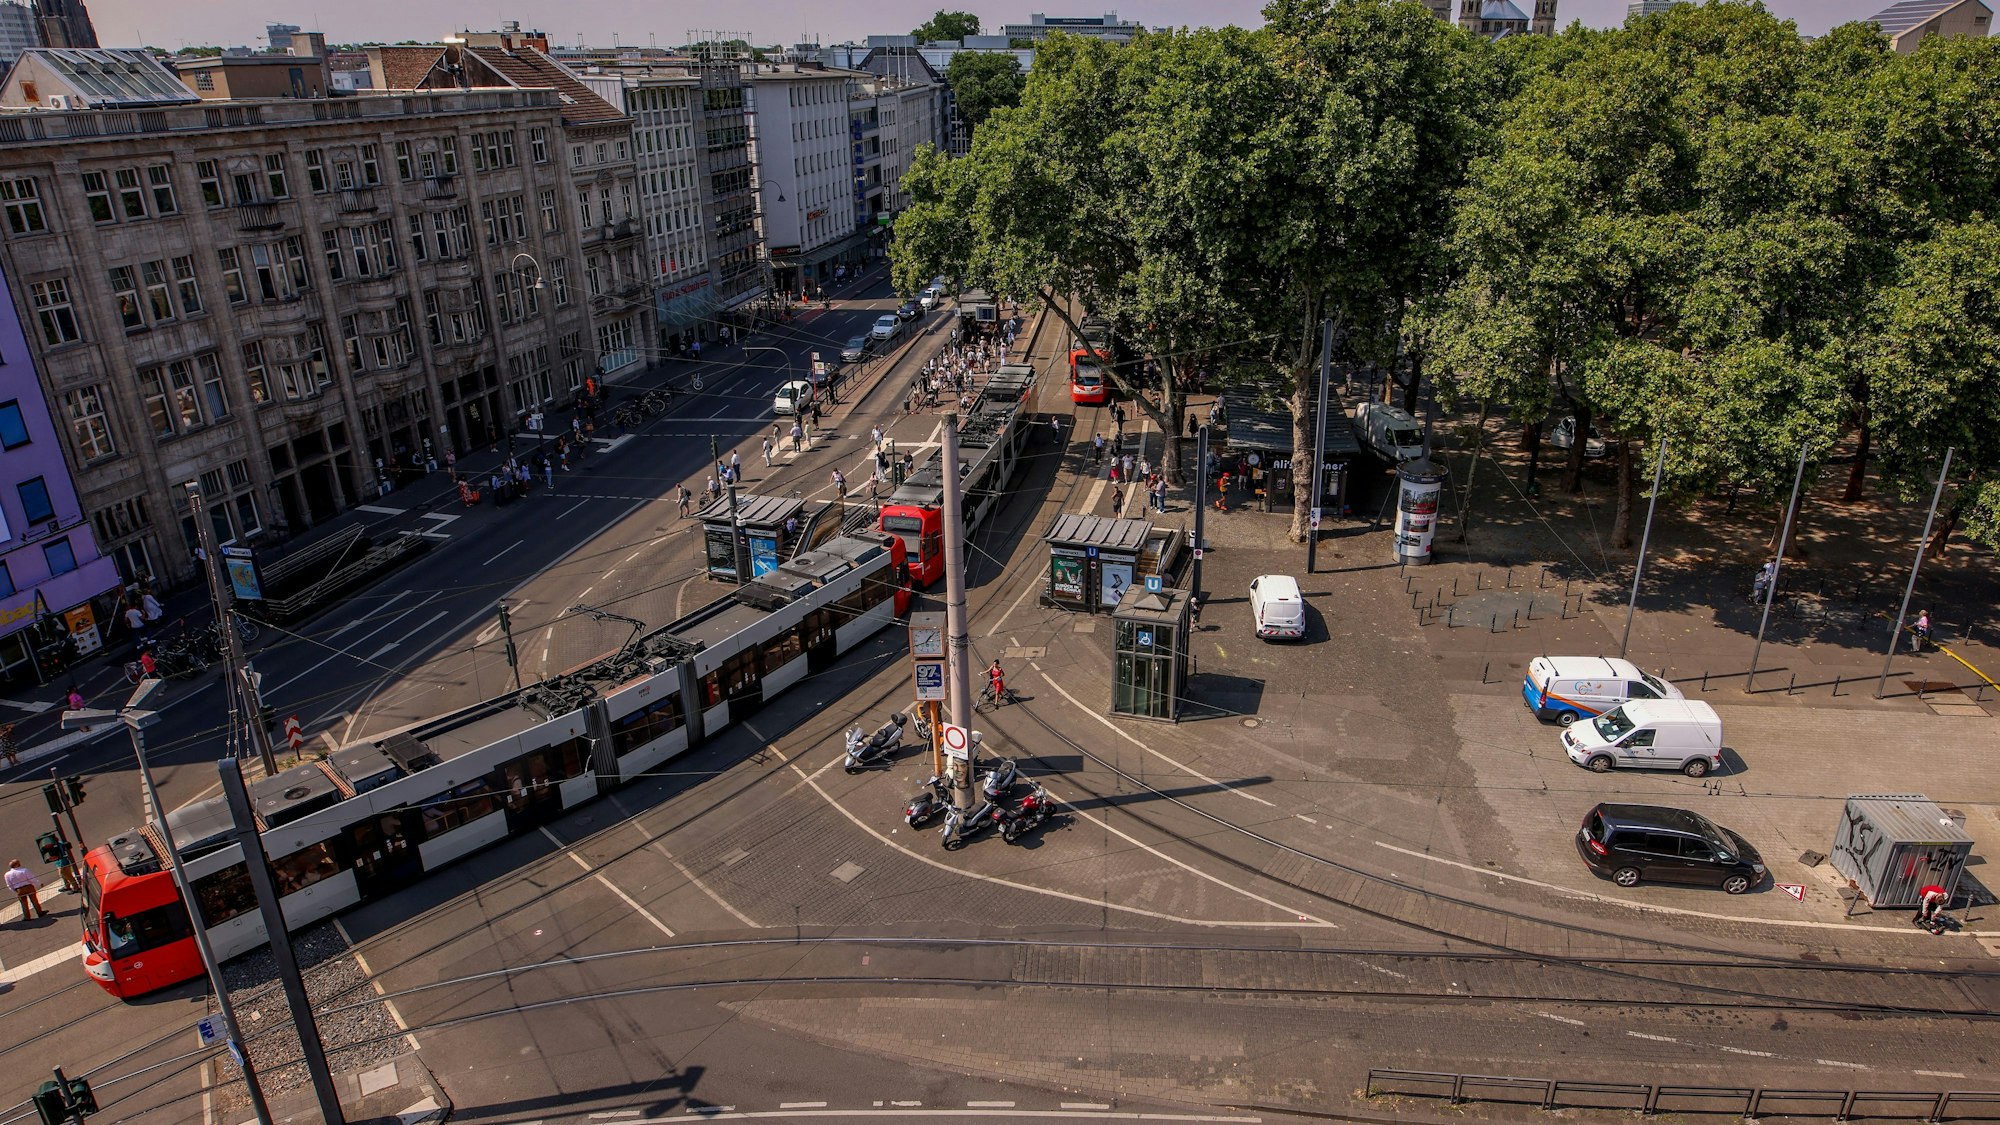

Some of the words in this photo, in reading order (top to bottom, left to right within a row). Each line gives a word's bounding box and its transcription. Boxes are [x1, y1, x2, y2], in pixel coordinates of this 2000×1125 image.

[1321, 461, 1344, 470] öner
[1089, 547, 1096, 556] U
[1148, 579, 1158, 590] U
